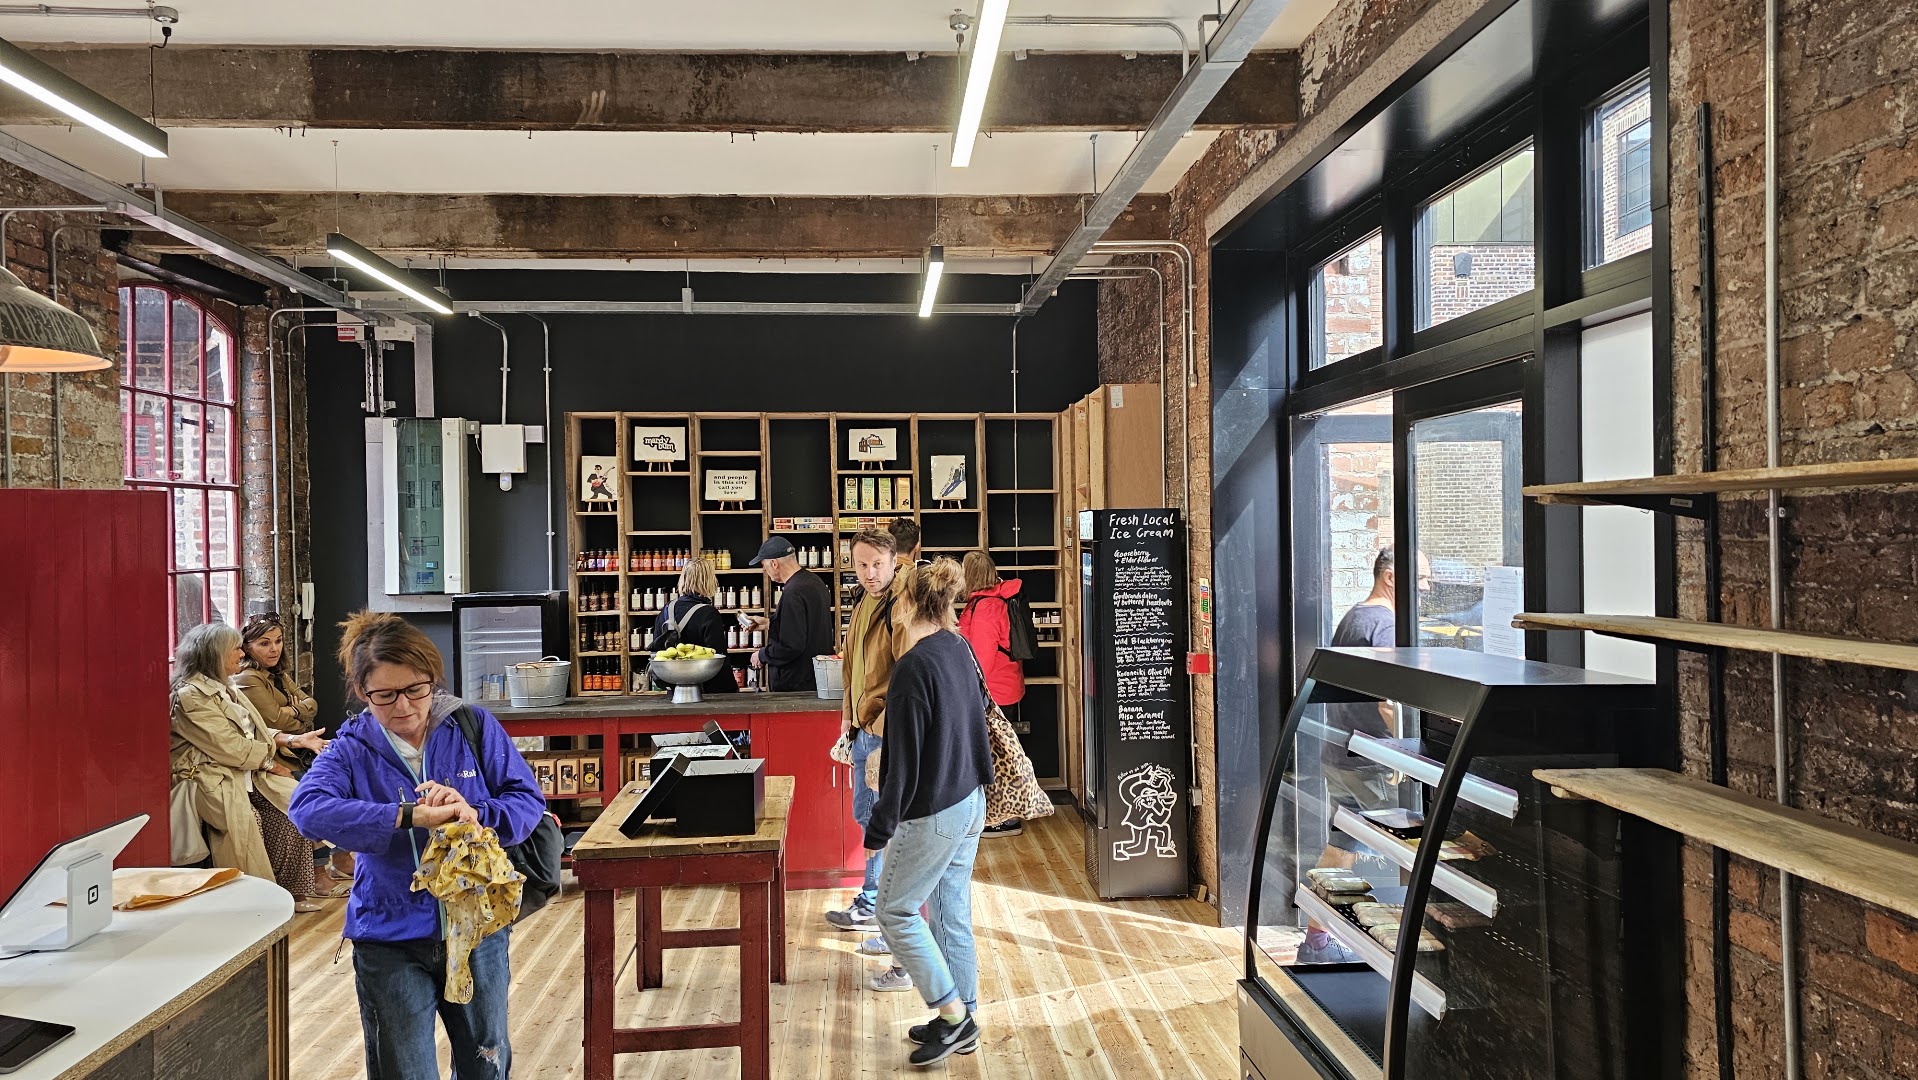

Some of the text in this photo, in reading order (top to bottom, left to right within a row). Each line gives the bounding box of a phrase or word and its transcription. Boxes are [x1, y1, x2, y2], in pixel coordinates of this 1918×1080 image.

[644, 435, 670, 447] mardy
[1109, 513, 1174, 526] Fresh Local
[1110, 528, 1174, 539] Ice Cream
[1114, 549, 1151, 557] Gooseberry
[1131, 637, 1164, 647] Blackberry
[1148, 668, 1162, 676] Olive
[1164, 667, 1172, 676] Oil
[1119, 705, 1143, 713] Banana
[1136, 710, 1164, 719] Caramel
